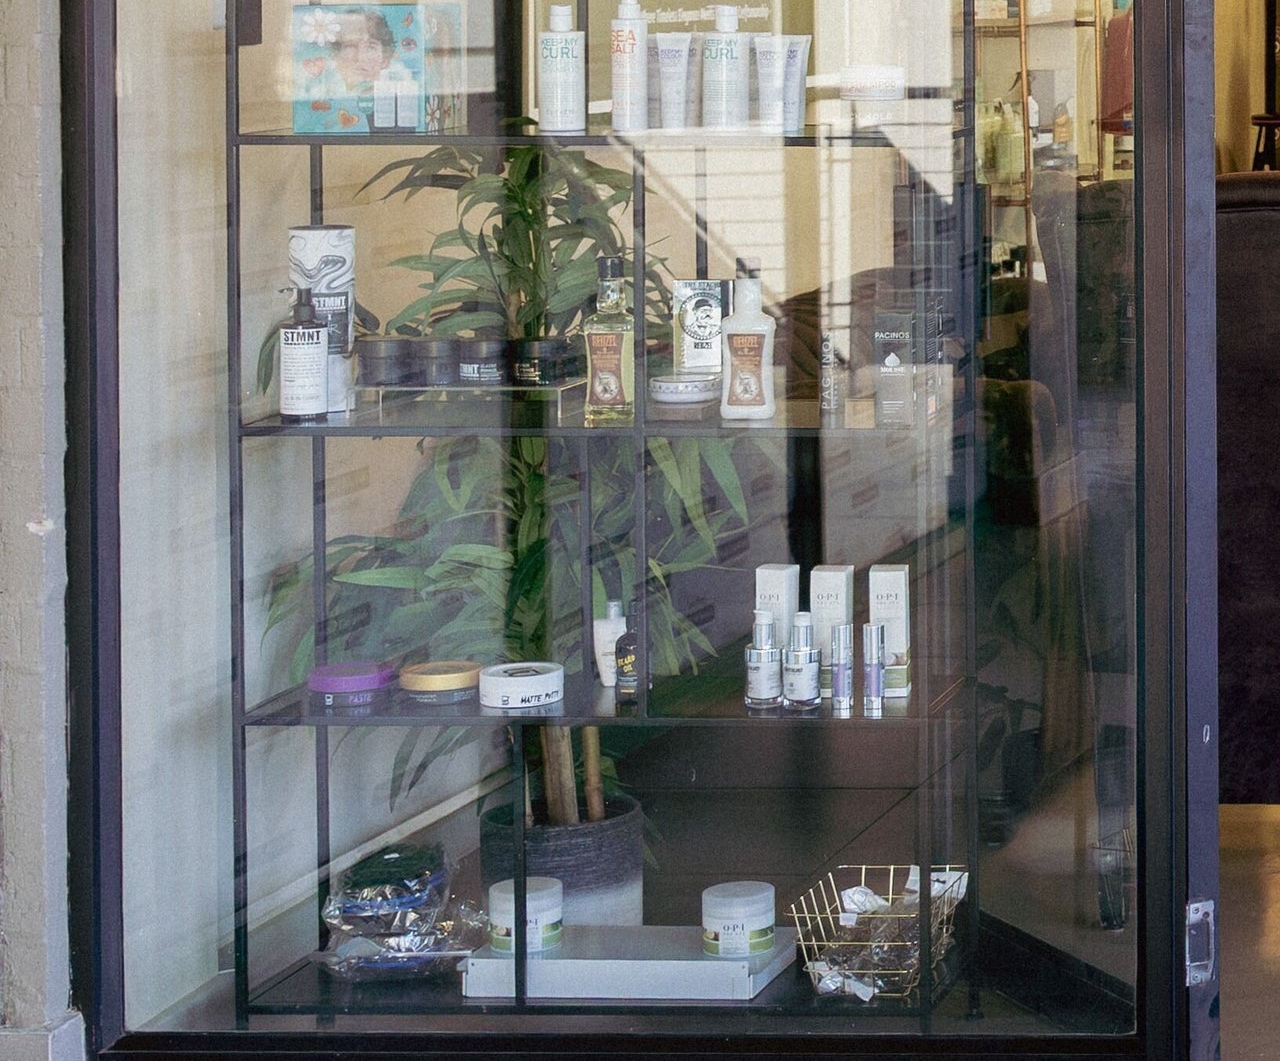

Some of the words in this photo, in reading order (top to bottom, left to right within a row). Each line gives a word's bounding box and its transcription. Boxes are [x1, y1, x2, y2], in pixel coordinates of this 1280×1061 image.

[611, 29, 636, 42] SEA
[541, 46, 578, 59] CURL
[610, 43, 636, 54] SALT
[703, 47, 738, 60] CURL
[283, 330, 322, 342] STMNT
[875, 331, 910, 339] PACINOS
[520, 694, 543, 705] MATTE
[544, 690, 560, 702] PUTTY
